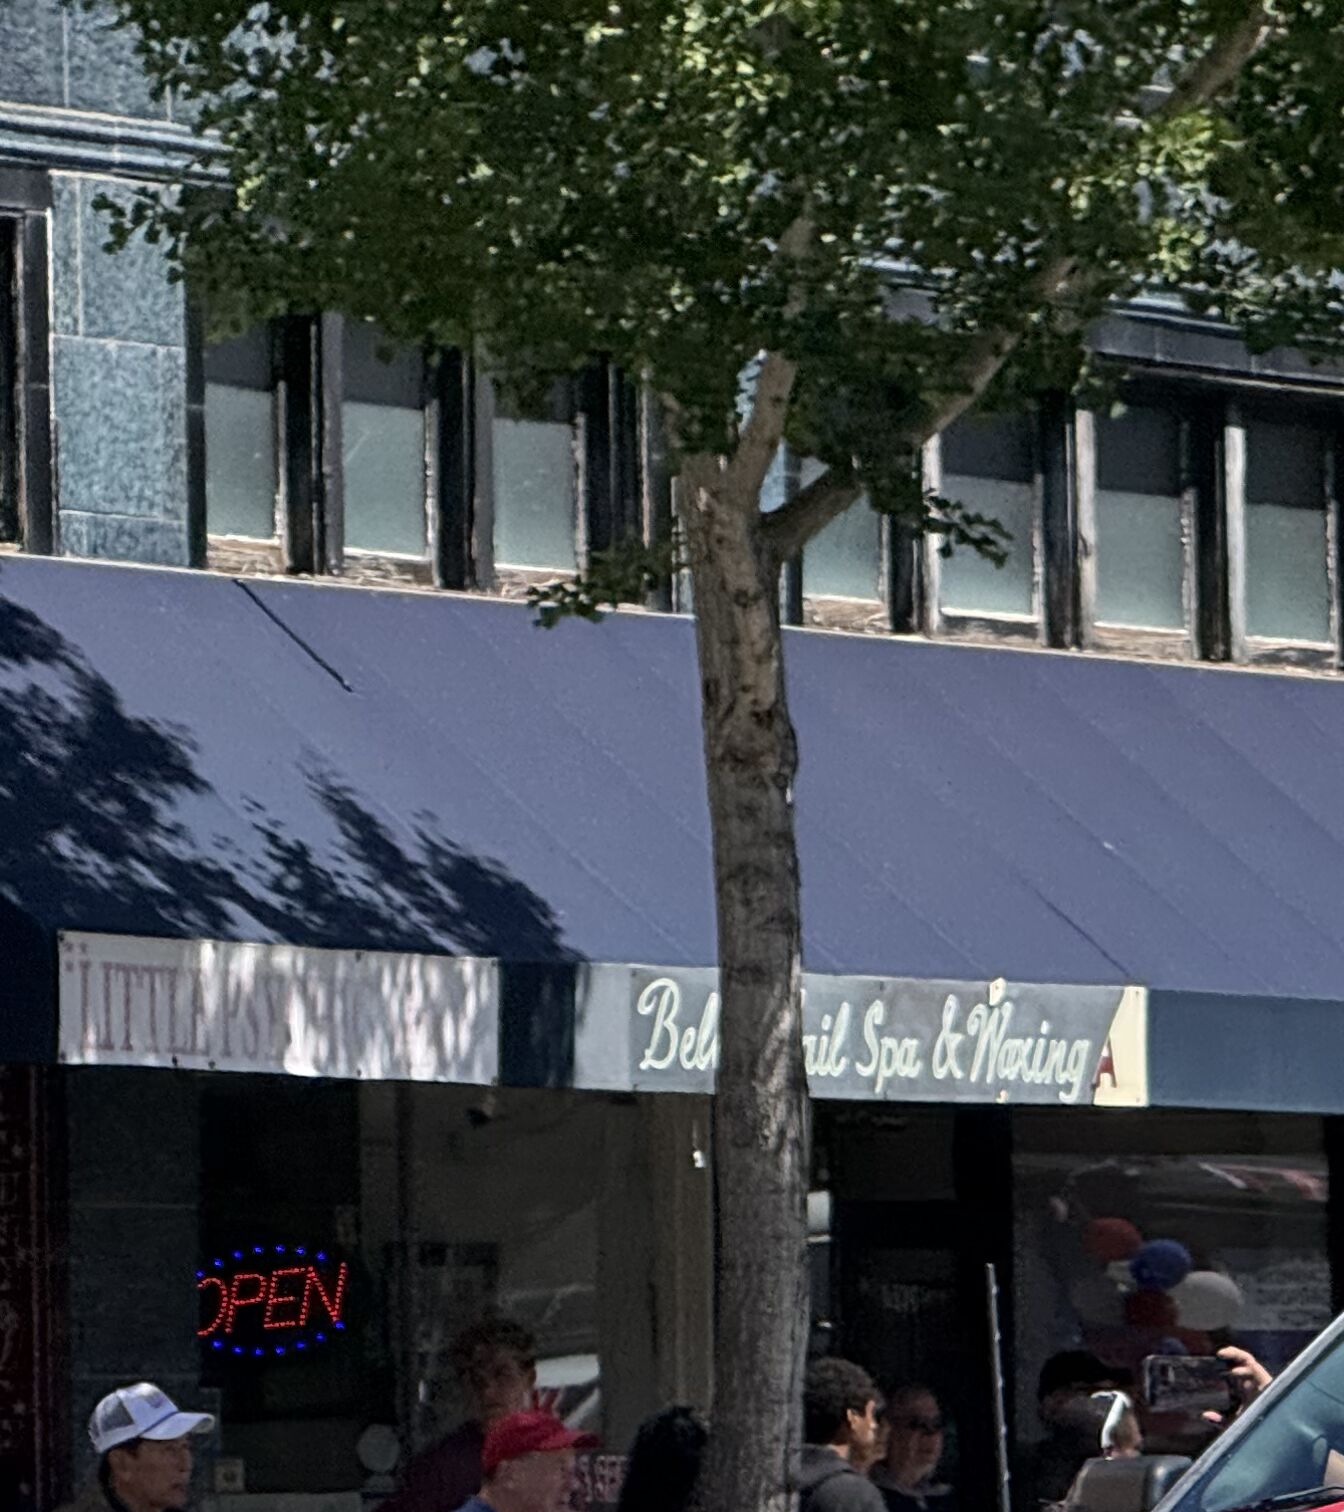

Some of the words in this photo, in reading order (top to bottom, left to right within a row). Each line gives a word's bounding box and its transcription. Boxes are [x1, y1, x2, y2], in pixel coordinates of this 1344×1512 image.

[637, 976, 719, 1071] Bel
[801, 989, 852, 1078] ail
[856, 999, 922, 1093] Spa
[933, 994, 966, 1081] &
[967, 1000, 1091, 1102] Waxing
[196, 1261, 348, 1337] OPEN
